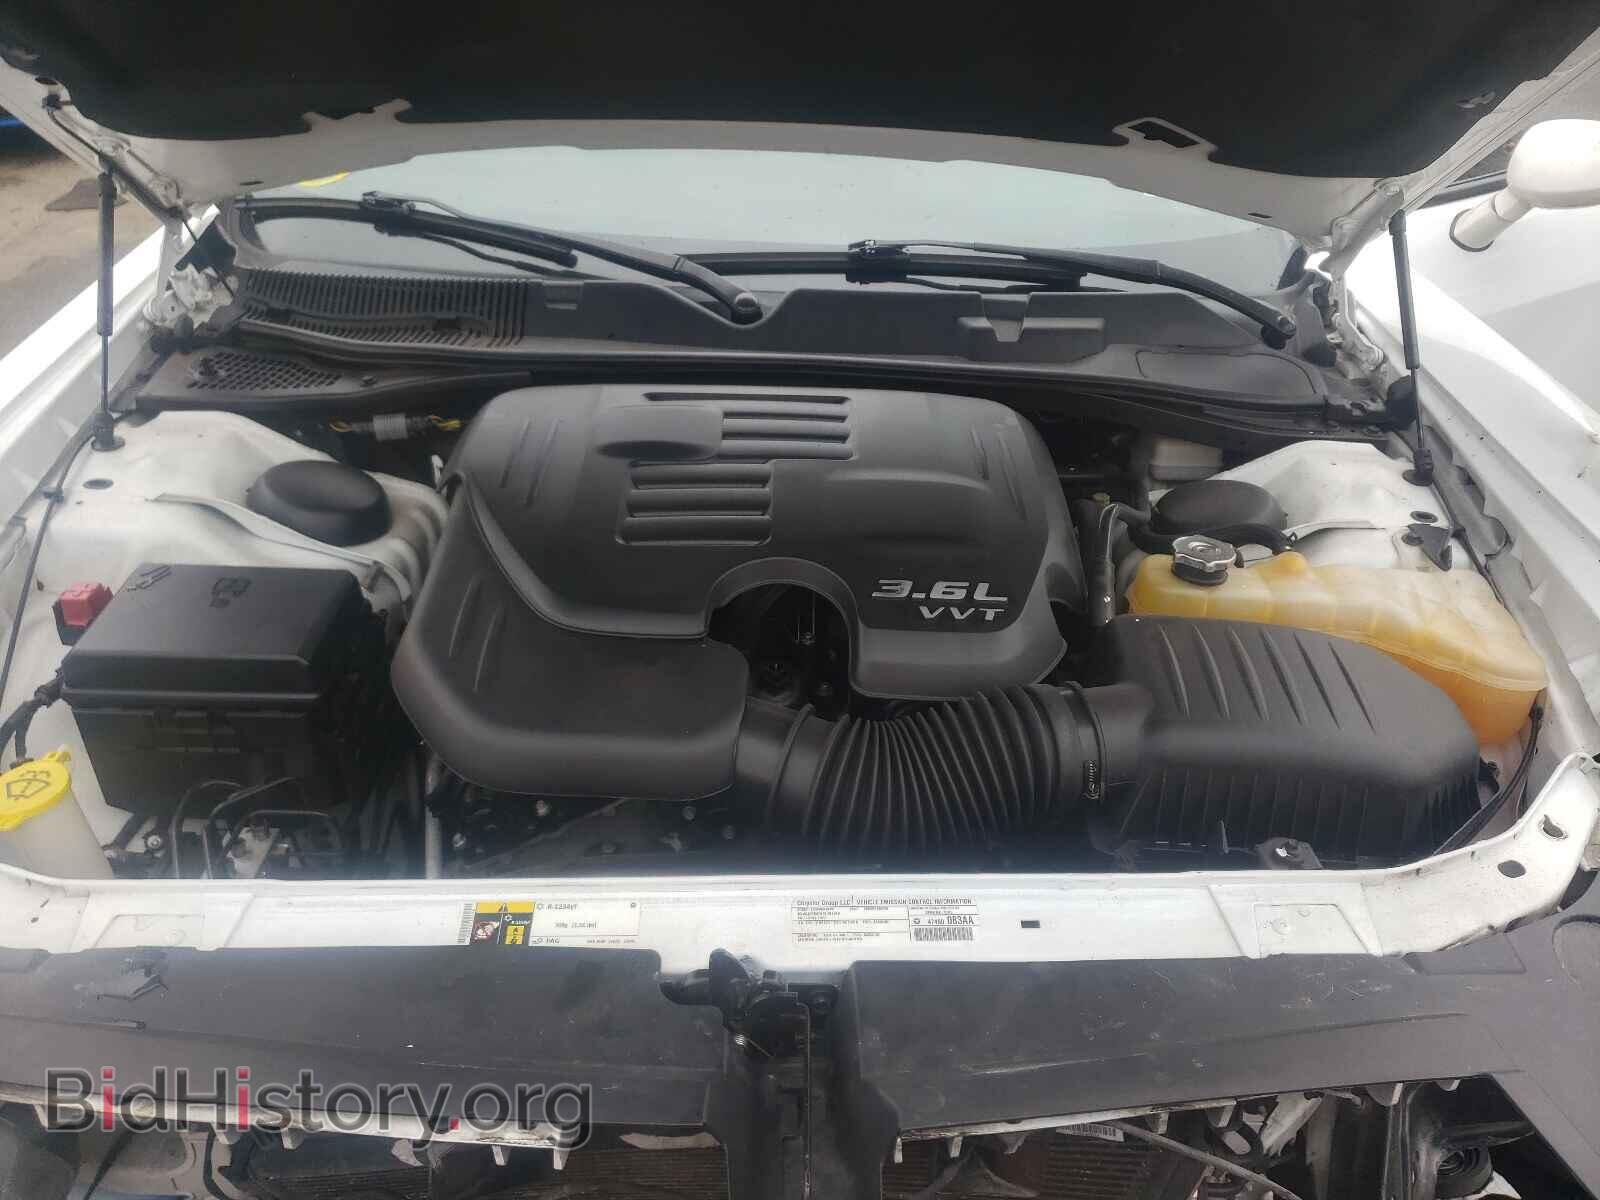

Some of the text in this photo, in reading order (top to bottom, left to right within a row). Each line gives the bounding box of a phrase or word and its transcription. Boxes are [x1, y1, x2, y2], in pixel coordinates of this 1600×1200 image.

[871, 579, 1009, 601] 3.6L
[919, 606, 1005, 621] VVT
[822, 898, 839, 907] Group
[839, 898, 851, 906] LLC
[934, 897, 972, 905] INFORMATION
